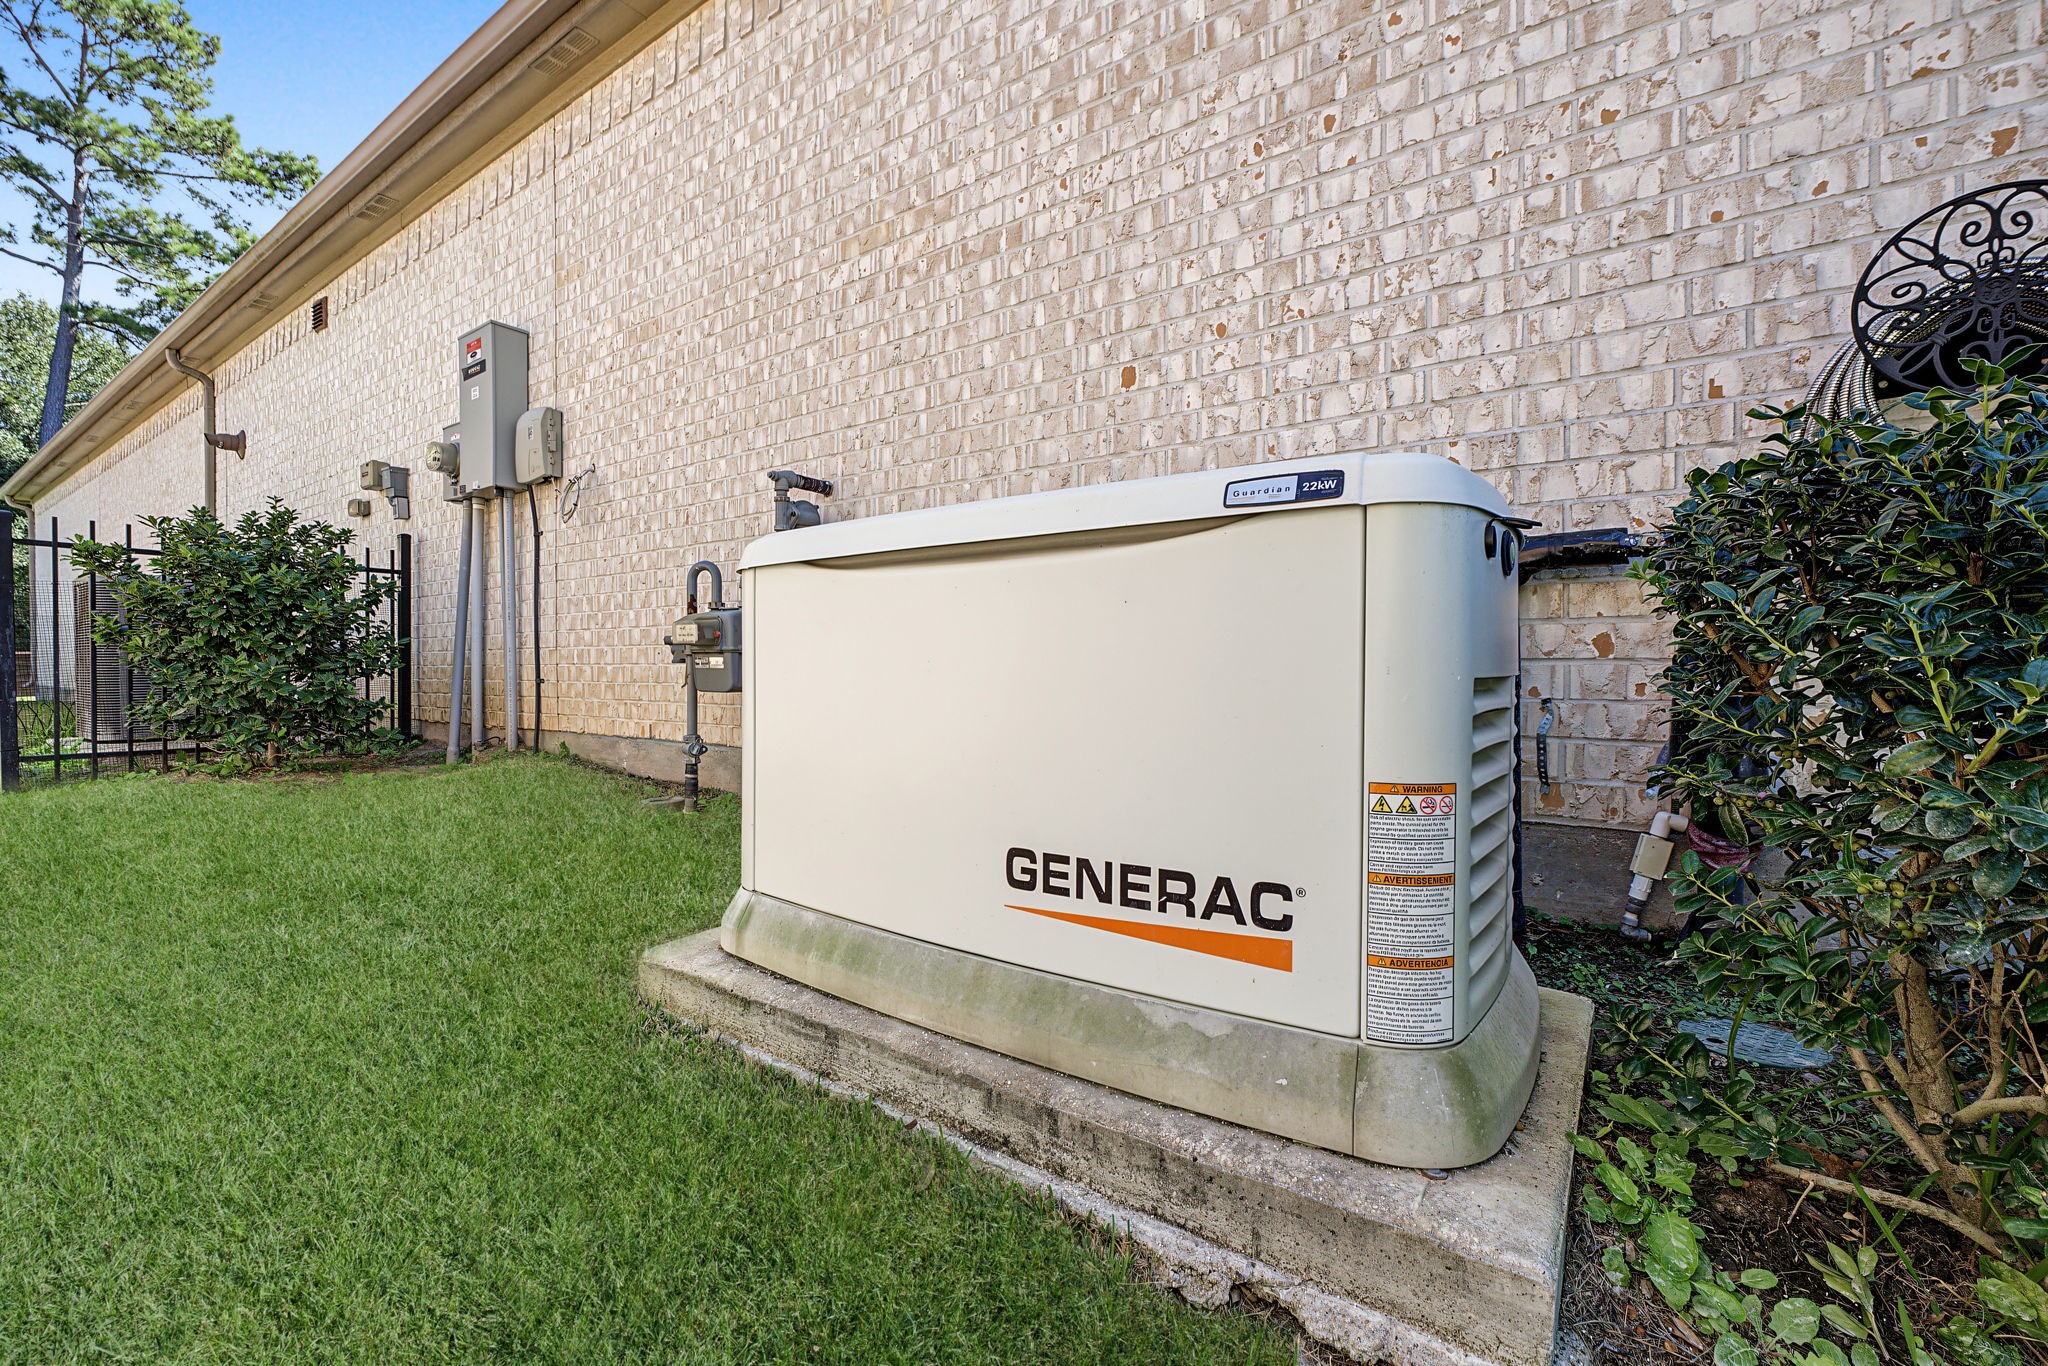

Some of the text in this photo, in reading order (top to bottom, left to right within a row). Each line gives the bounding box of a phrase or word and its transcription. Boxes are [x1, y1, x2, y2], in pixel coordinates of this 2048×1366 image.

[1233, 479, 1338, 498] Guardian 22kW
[1383, 875, 1453, 885] AVERTISSEMENT
[1389, 959, 1449, 968] ADVERTENCIA
